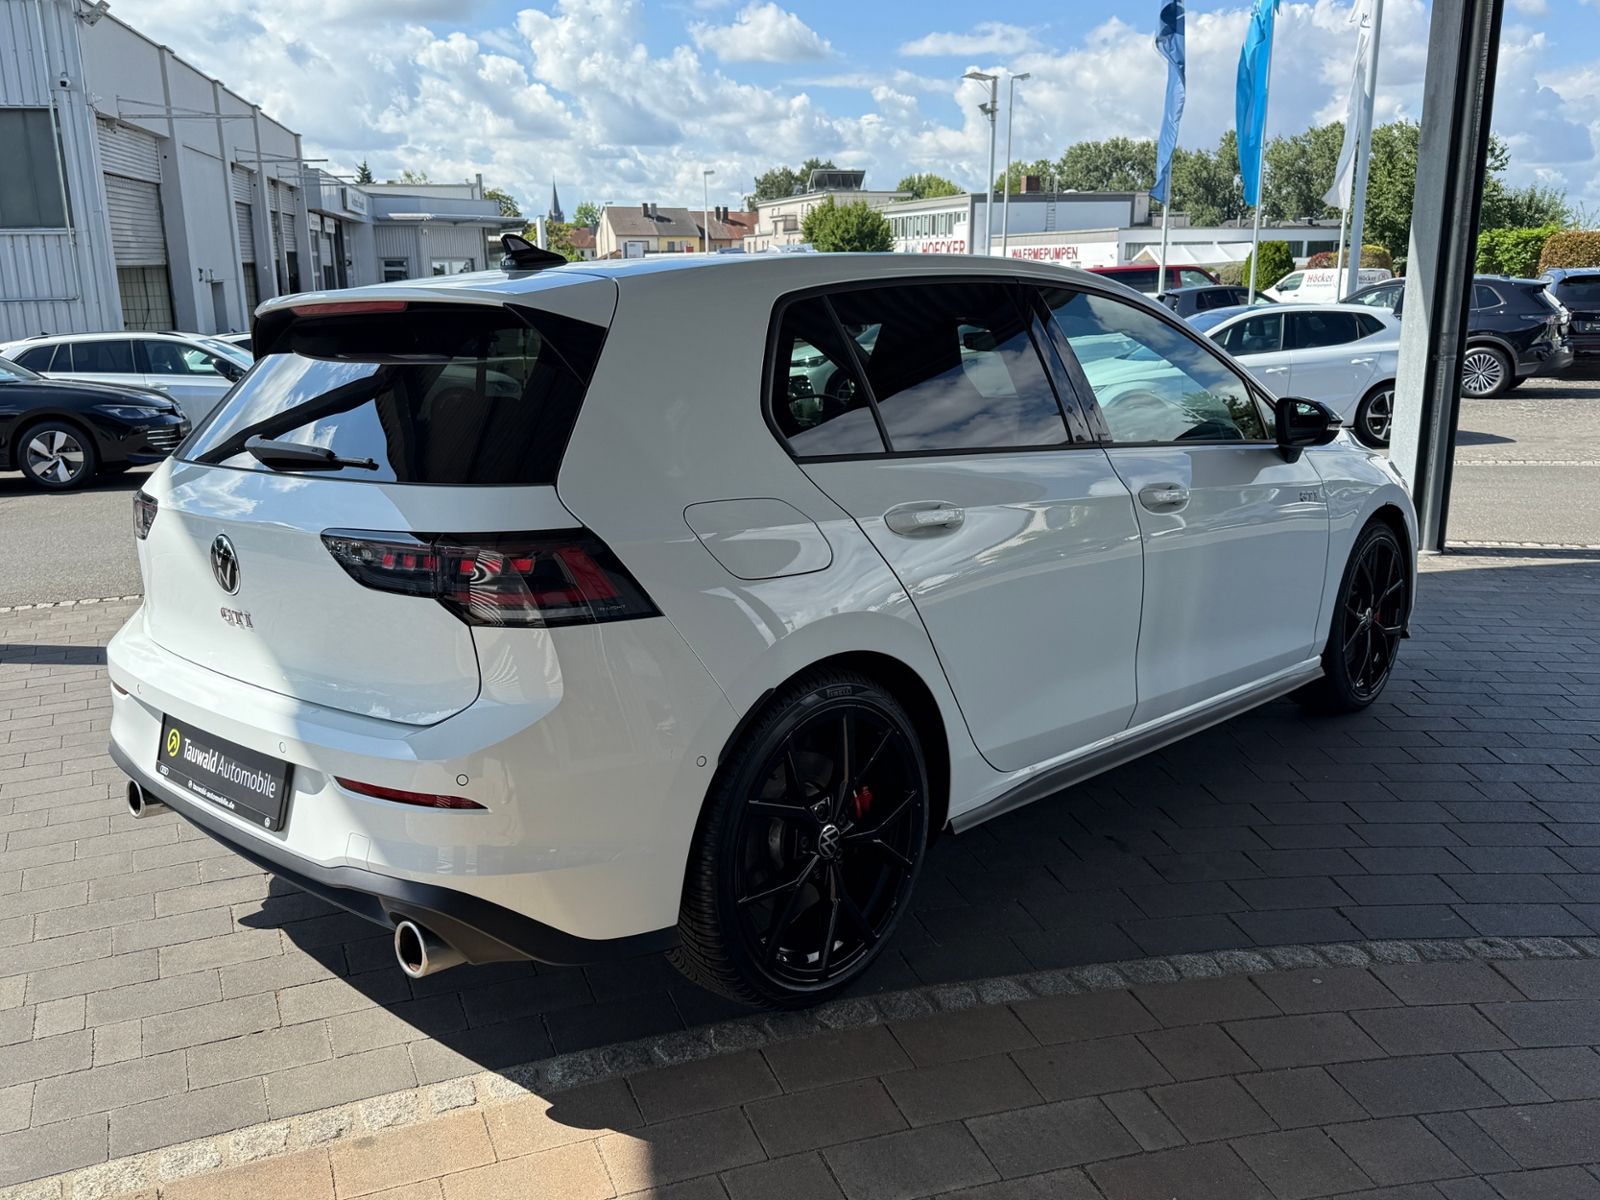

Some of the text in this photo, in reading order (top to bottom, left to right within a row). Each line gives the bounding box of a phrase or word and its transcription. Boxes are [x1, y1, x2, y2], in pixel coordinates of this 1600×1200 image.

[1011, 246, 1078, 260] WAERMEPUMPEN
[1306, 273, 1333, 282] Höcker
[183, 737, 276, 799] Tauwald Automobile
